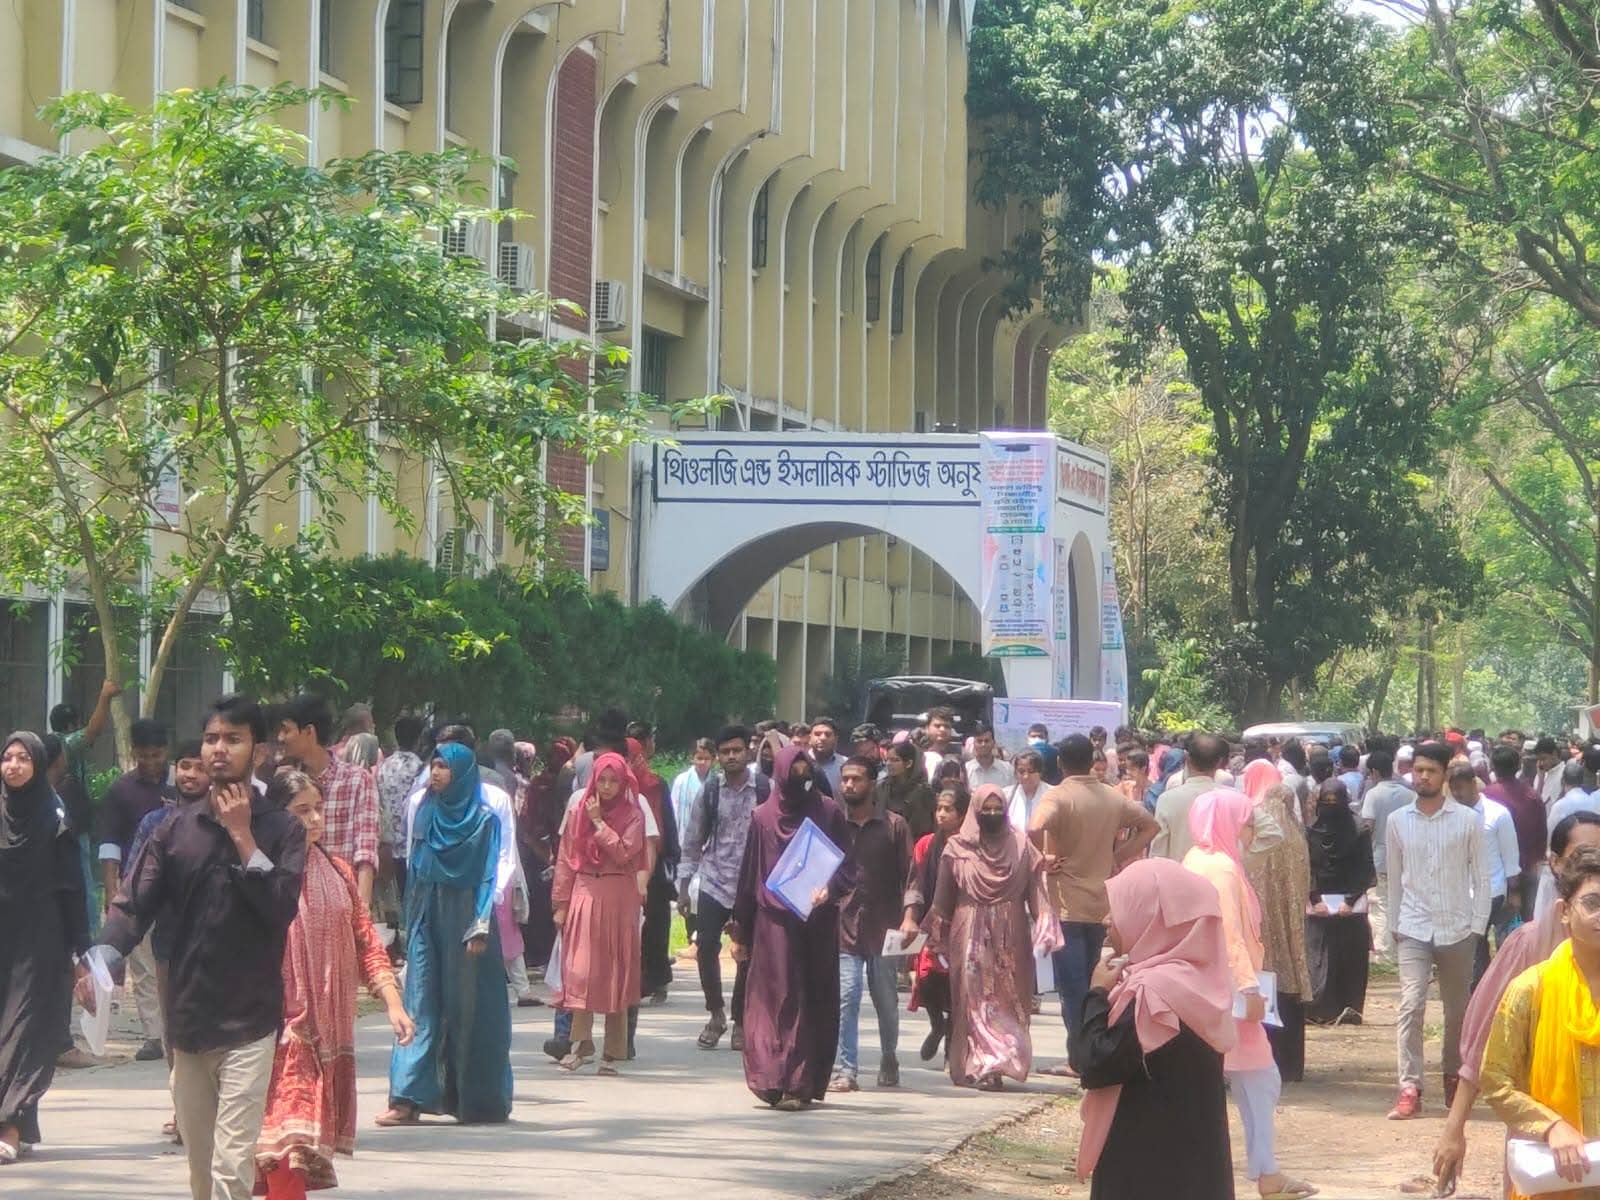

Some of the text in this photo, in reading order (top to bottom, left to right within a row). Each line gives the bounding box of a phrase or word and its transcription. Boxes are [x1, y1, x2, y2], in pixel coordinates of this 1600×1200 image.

[662, 449, 738, 485] থিওলজি
[777, 449, 860, 487] ইসলামিক
[866, 451, 931, 488] স্টাডিজ
